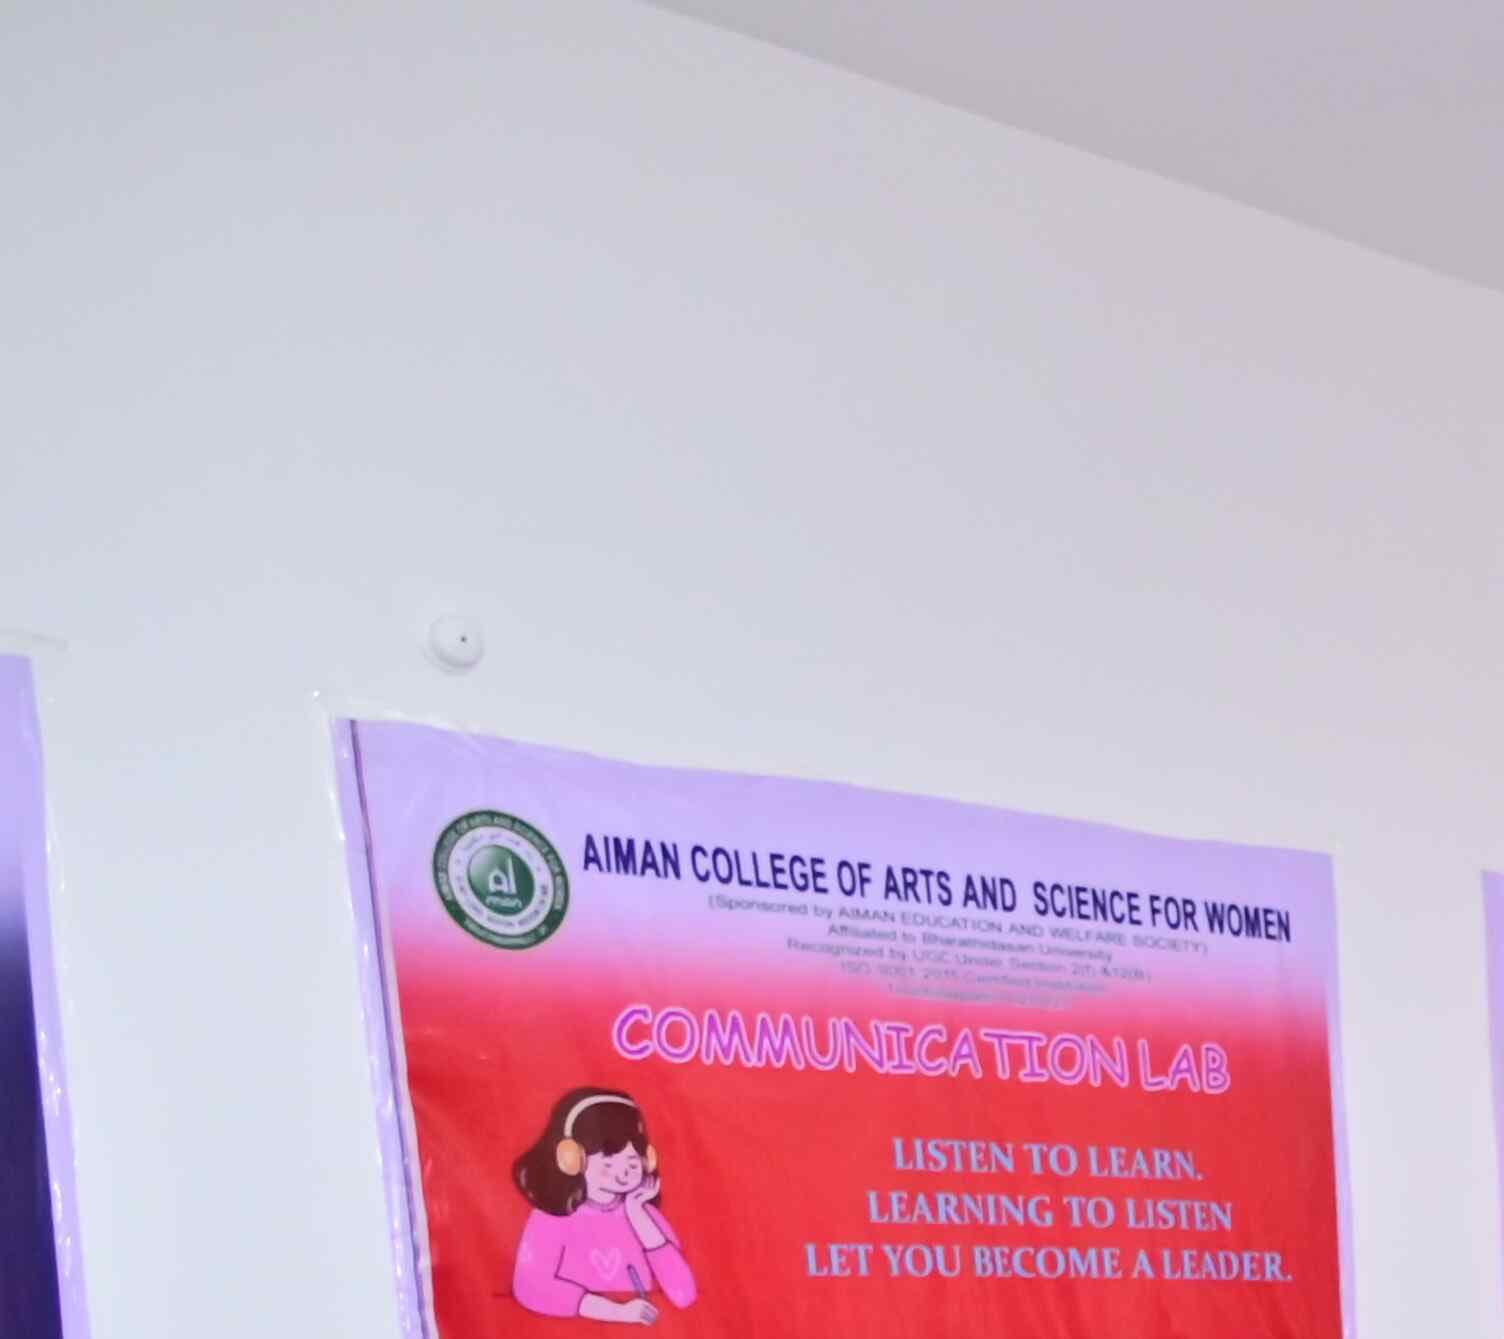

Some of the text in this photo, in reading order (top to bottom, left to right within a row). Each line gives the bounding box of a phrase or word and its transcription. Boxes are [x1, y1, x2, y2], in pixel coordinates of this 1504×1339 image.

[583, 834, 1291, 942] AIMAN COLLEGE OF ARTS AND SCIENCE FOR WOMEN
[1009, 924, 1044, 938] AND
[612, 1003, 1230, 1094] COMMUNICATION LAB
[892, 1136, 1203, 1181] LISTEN TO LEARN.
[866, 1190, 1233, 1232] LEARNING TO LISTEN
[805, 1243, 1293, 1282] LET YOU BECOME A LEADER.
